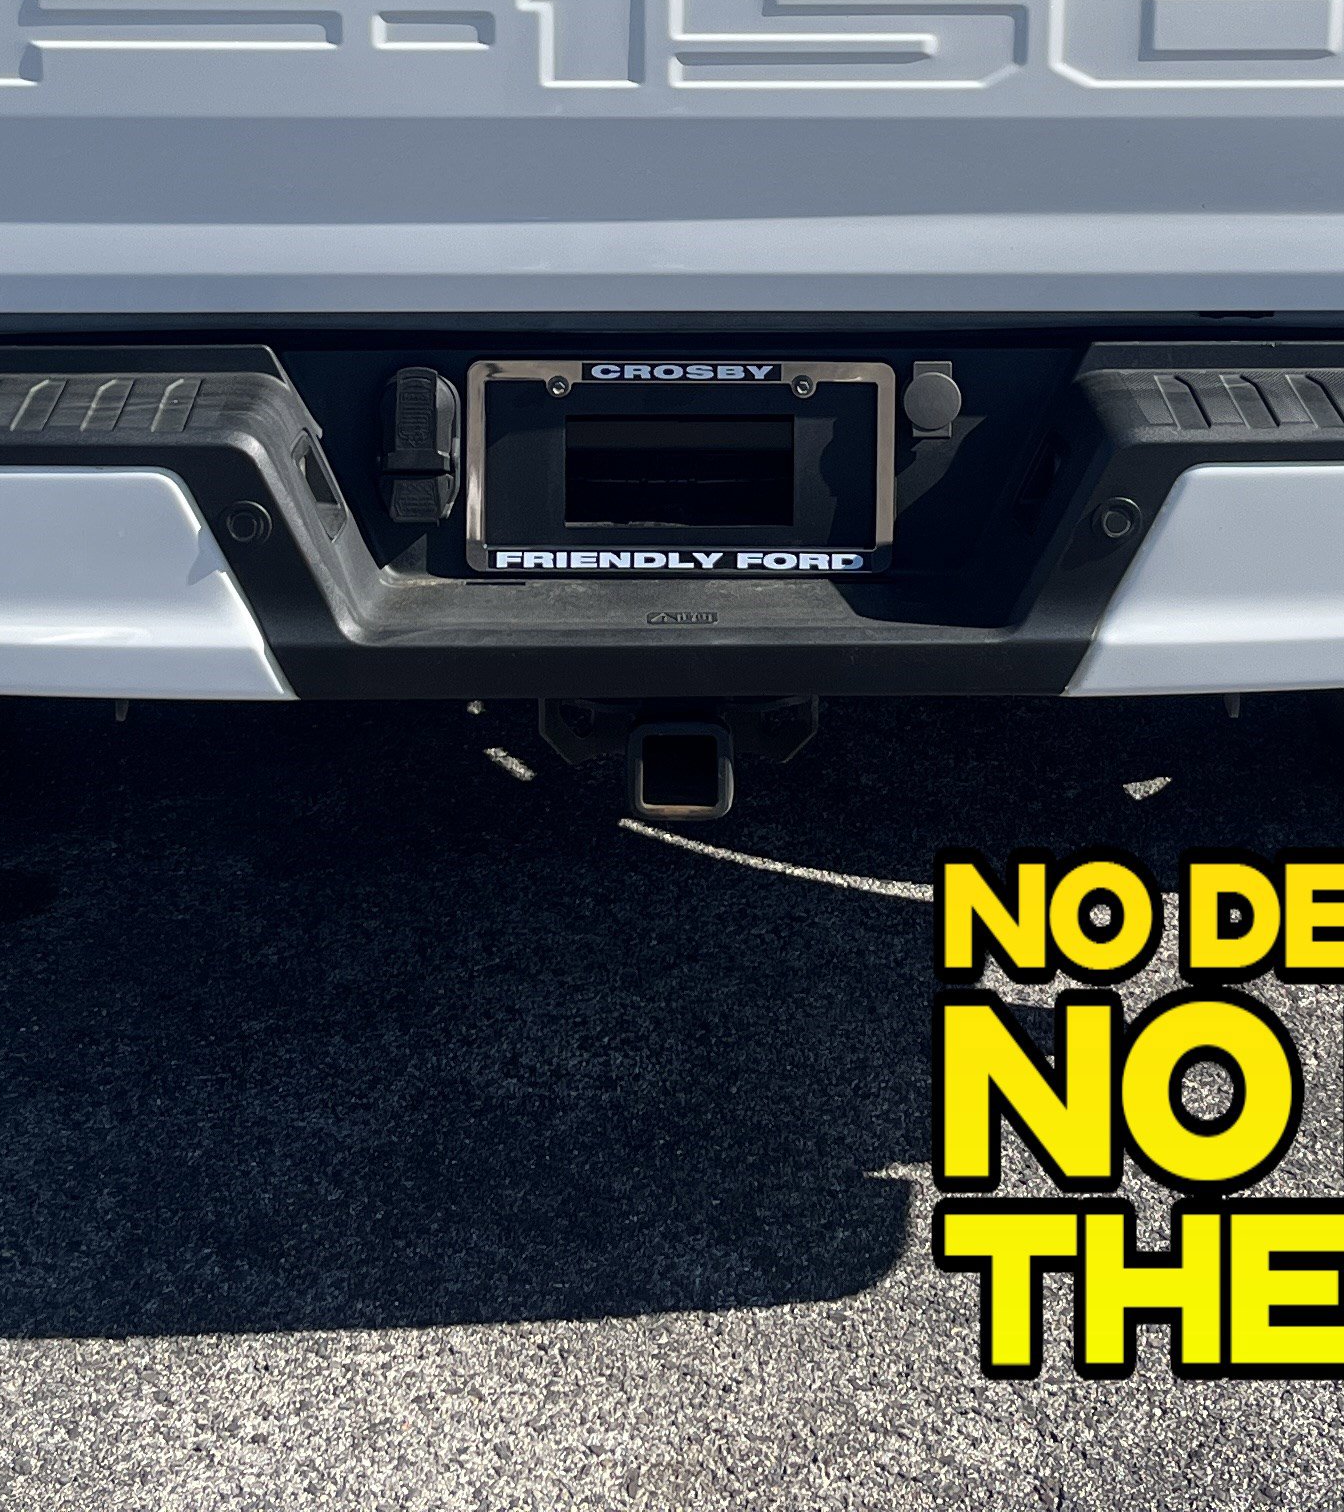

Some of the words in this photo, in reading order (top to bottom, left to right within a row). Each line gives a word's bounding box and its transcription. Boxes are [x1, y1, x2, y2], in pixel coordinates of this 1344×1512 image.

[590, 364, 774, 380] CROSBY
[495, 551, 726, 569] FRIENDLY
[736, 551, 864, 570] FORD
